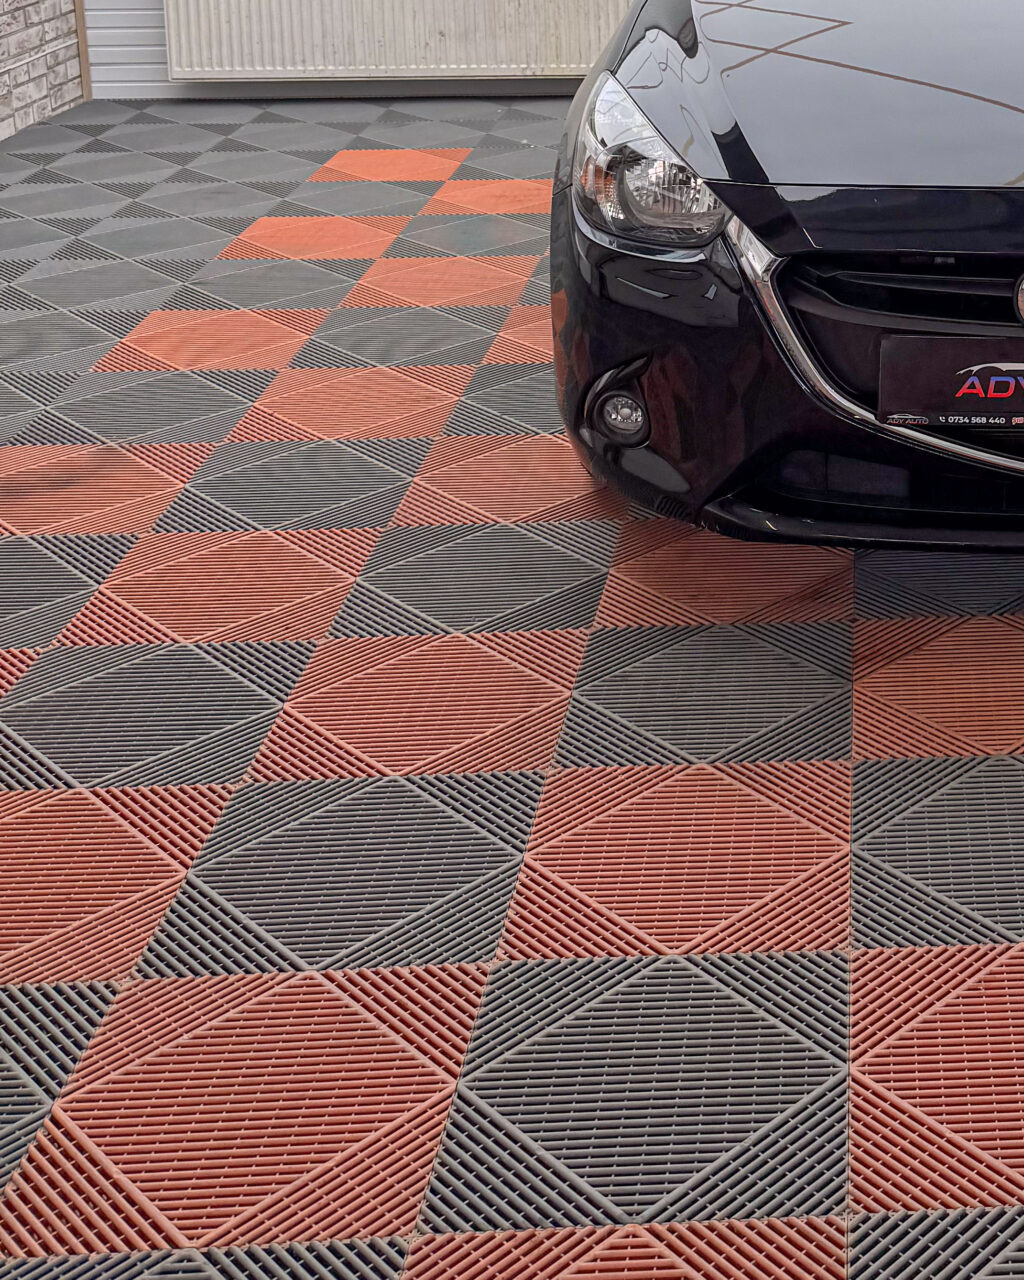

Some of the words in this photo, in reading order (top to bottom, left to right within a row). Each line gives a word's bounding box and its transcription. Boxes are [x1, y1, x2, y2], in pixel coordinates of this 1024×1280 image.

[886, 417, 905, 425] ADY
[905, 417, 929, 425] AUTO
[948, 416, 970, 424] 0734
[971, 416, 987, 424] 568
[988, 416, 1006, 424] 440
